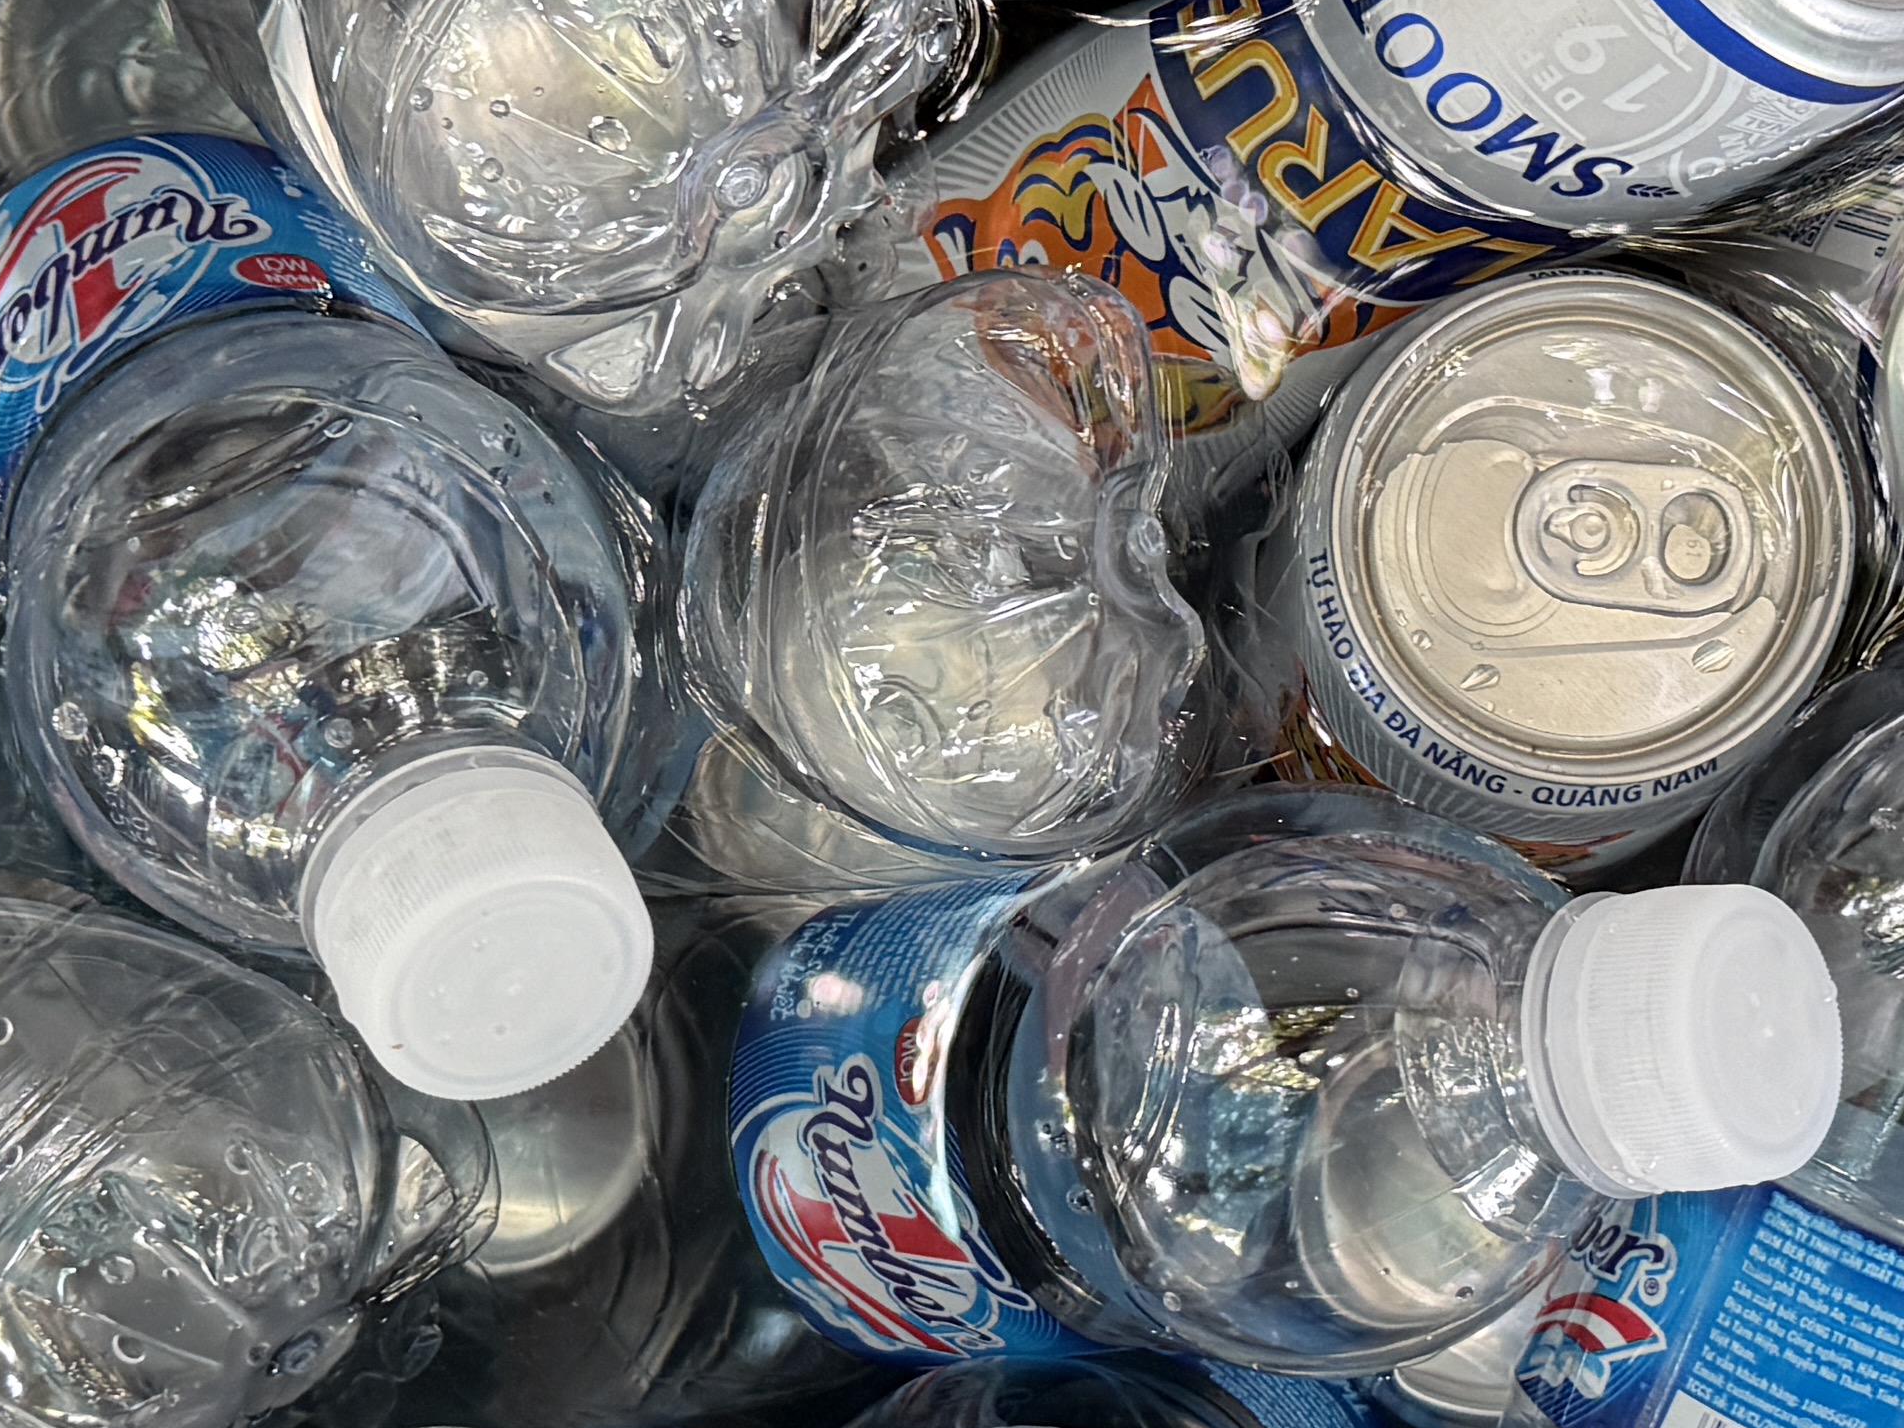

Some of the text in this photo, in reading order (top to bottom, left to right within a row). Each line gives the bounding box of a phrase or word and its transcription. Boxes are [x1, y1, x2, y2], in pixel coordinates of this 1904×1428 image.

[254, 253, 309, 277] MỚI
[1305, 548, 1719, 808] TỰ HÀO ĐÀ NẴNG QUẢNG NAM
[806, 1063, 969, 1329] Number
[1788, 1265, 1812, 1286] 219
